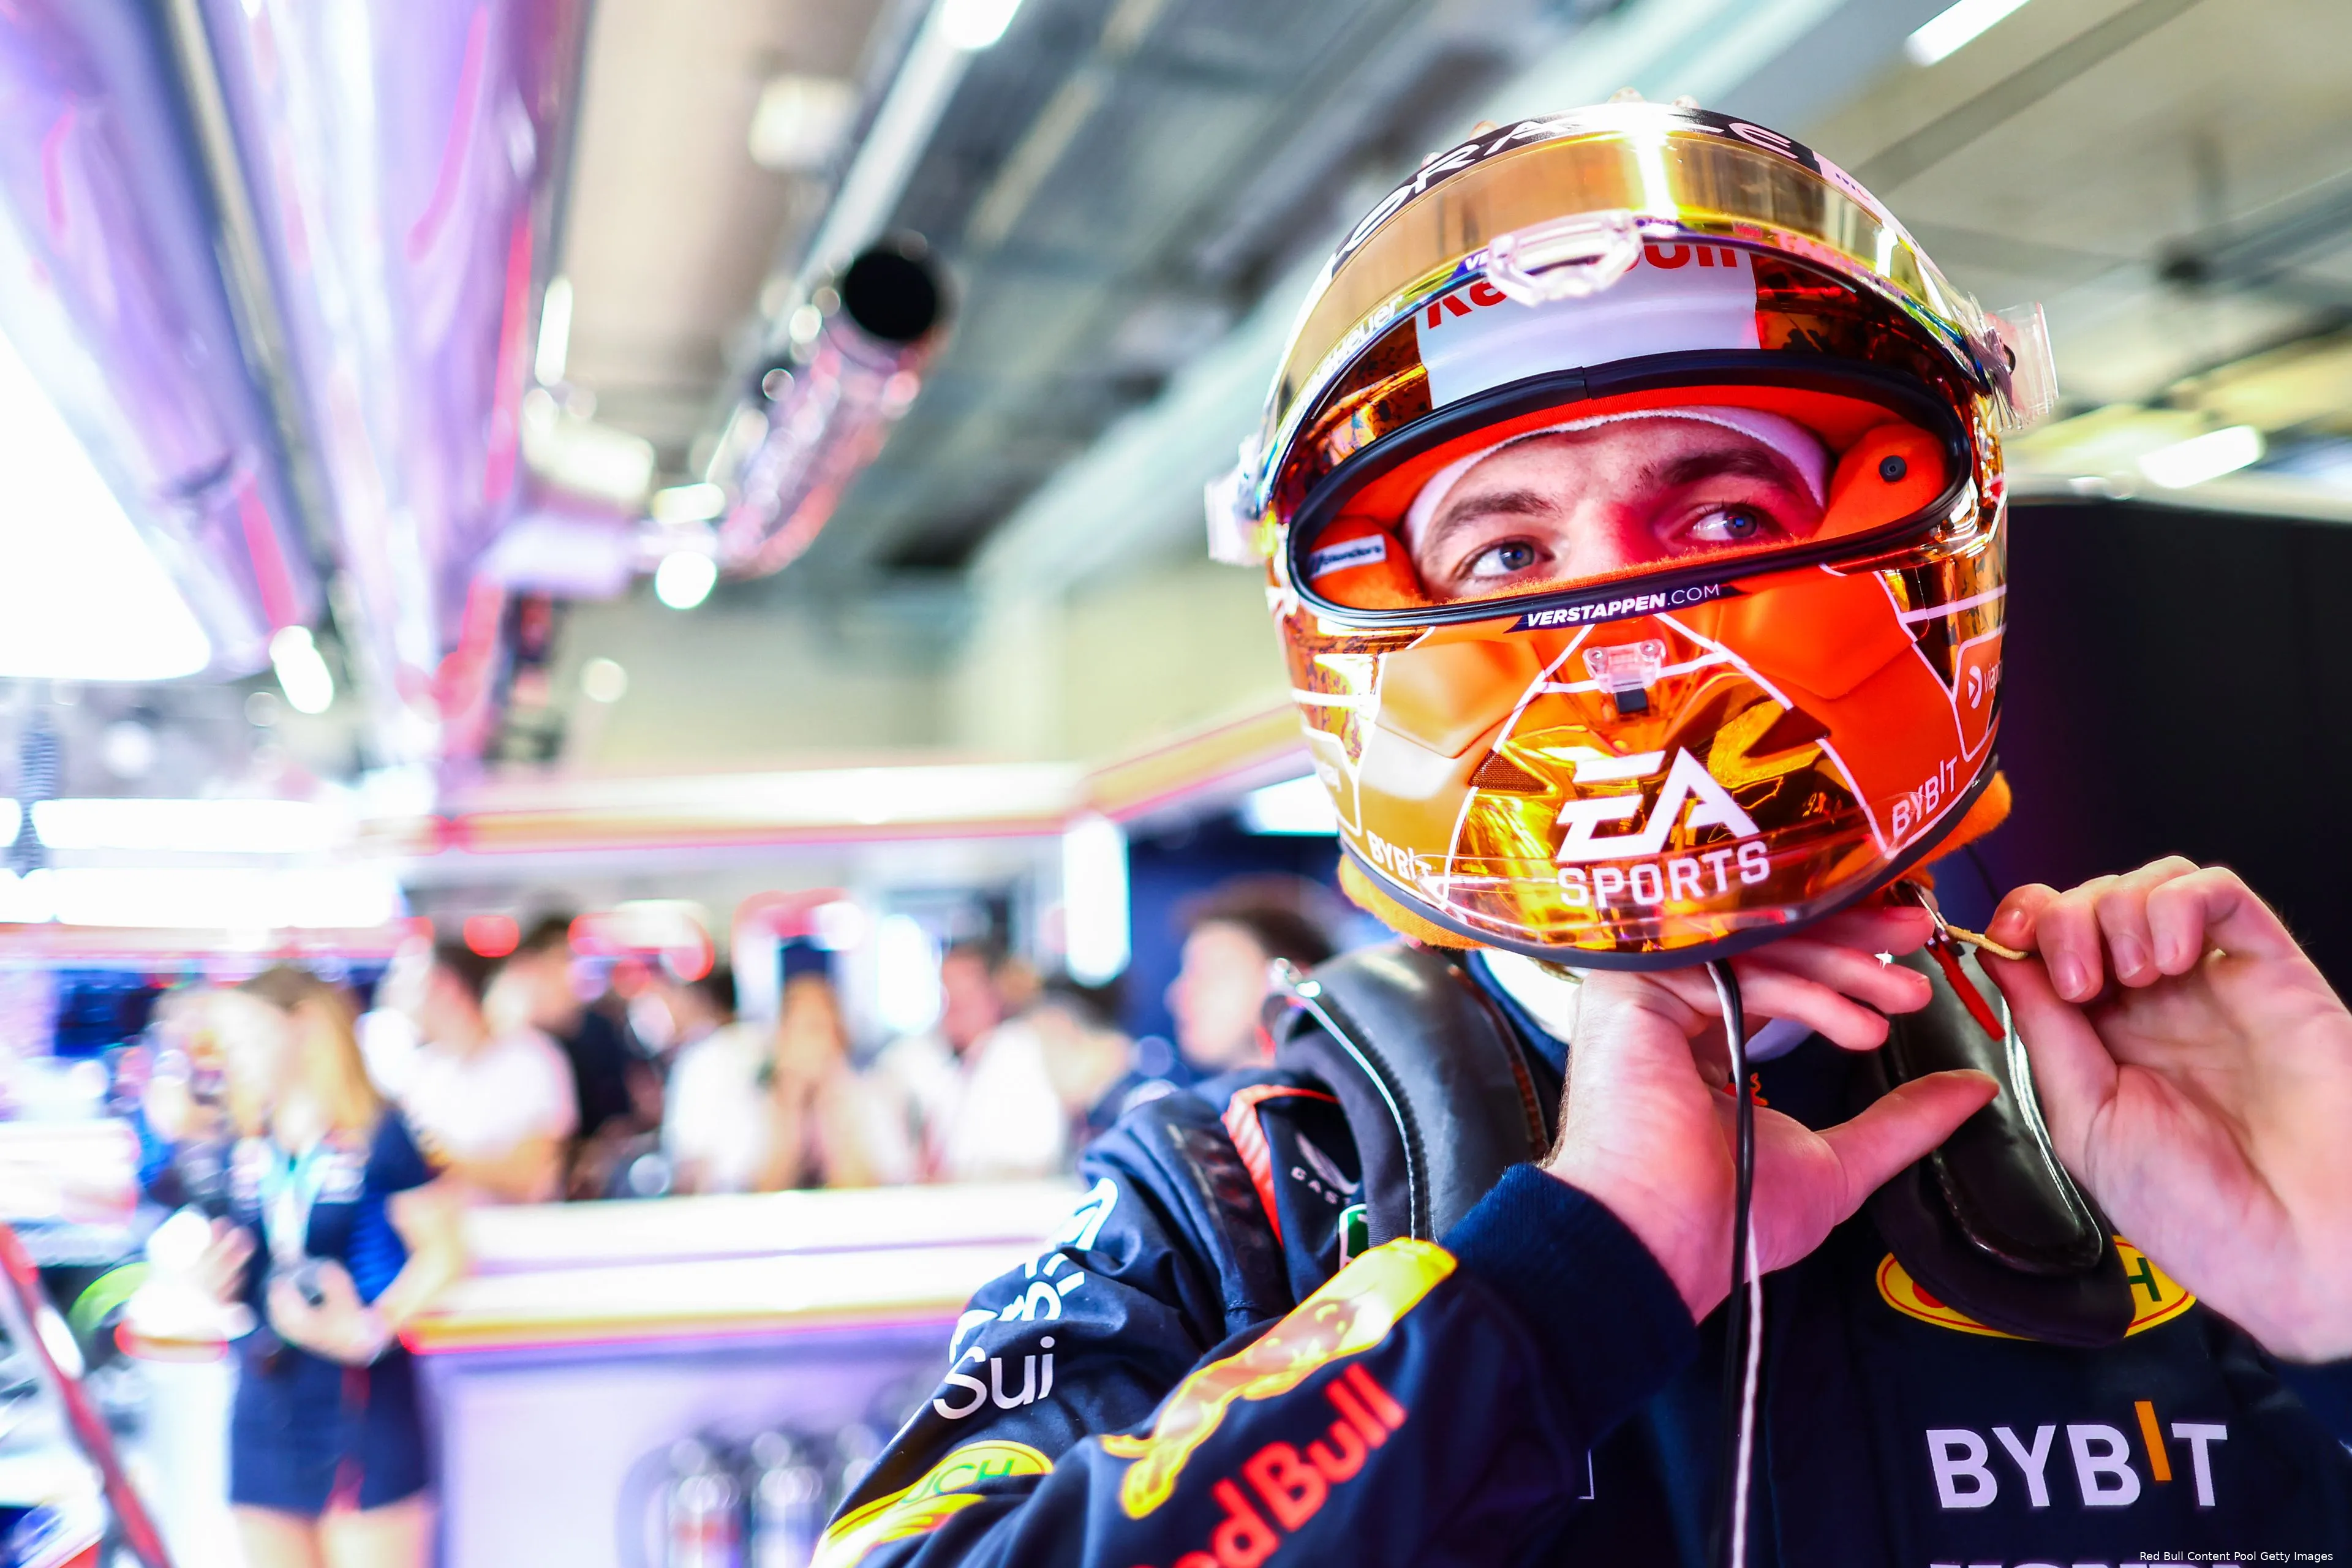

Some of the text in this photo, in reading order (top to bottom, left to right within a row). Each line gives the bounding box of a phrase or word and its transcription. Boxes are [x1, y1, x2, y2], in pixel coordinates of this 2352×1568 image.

[1343, 115, 1799, 252] ORAE
[1527, 583, 1721, 627] VERSTAPPEN.COM
[1556, 747, 1760, 863] EA
[1891, 755, 1958, 838] BYBIT
[1366, 829, 1432, 883] BYBIT
[1557, 841, 1771, 908] SPORTS
[932, 1336, 1055, 1420] Sui
[1242, 1362, 1408, 1533] Bull
[1925, 1400, 2228, 1509] BYBIT
